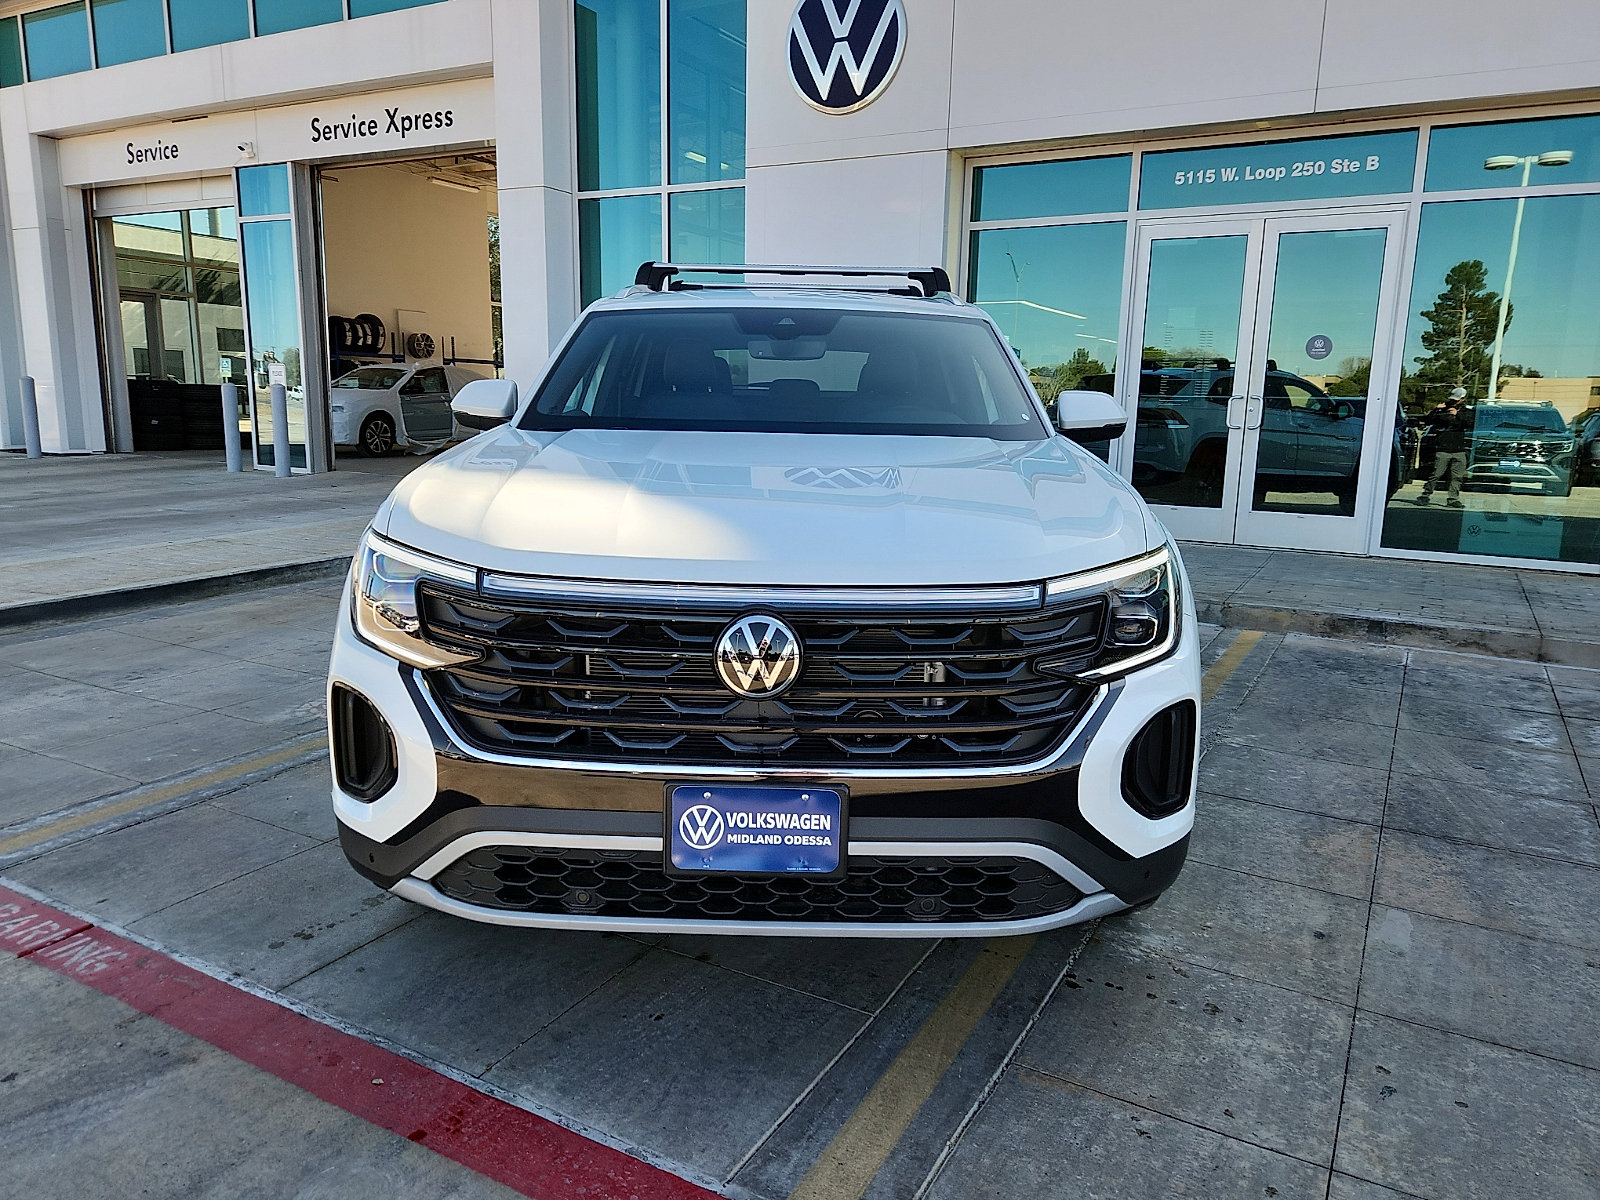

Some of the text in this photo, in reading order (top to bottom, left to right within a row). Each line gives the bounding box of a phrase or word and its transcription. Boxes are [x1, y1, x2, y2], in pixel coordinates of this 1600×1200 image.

[310, 107, 454, 143] Service Xpress
[126, 139, 179, 165] Service
[1174, 155, 1380, 185] 5115 W. Loop 250 Ste B
[681, 807, 723, 847] VW
[725, 812, 831, 831] VOLKSWAGEN
[727, 833, 832, 846] MIDLAND ODESSA
